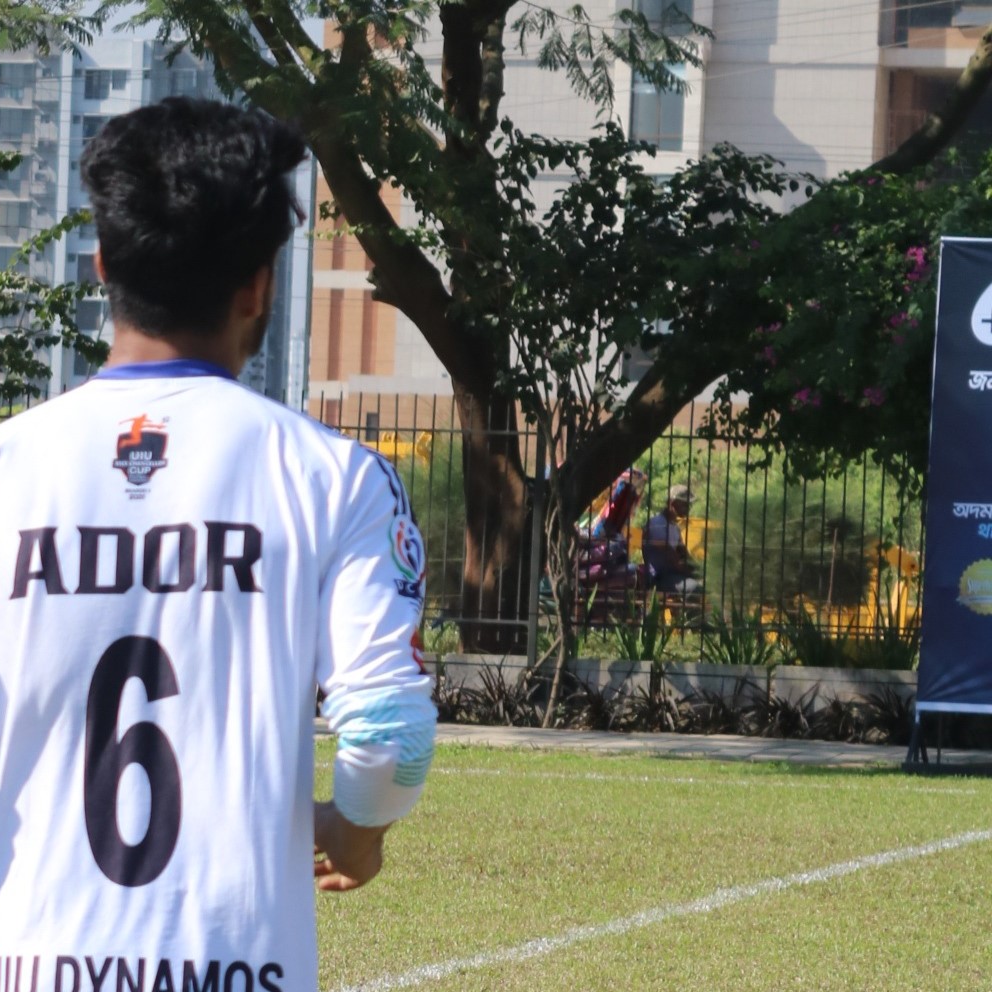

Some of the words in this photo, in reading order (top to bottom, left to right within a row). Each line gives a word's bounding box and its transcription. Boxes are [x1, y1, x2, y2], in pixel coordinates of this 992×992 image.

[129, 466, 151, 474] CUP
[9, 521, 264, 600] ADOR
[83, 634, 183, 888] 6
